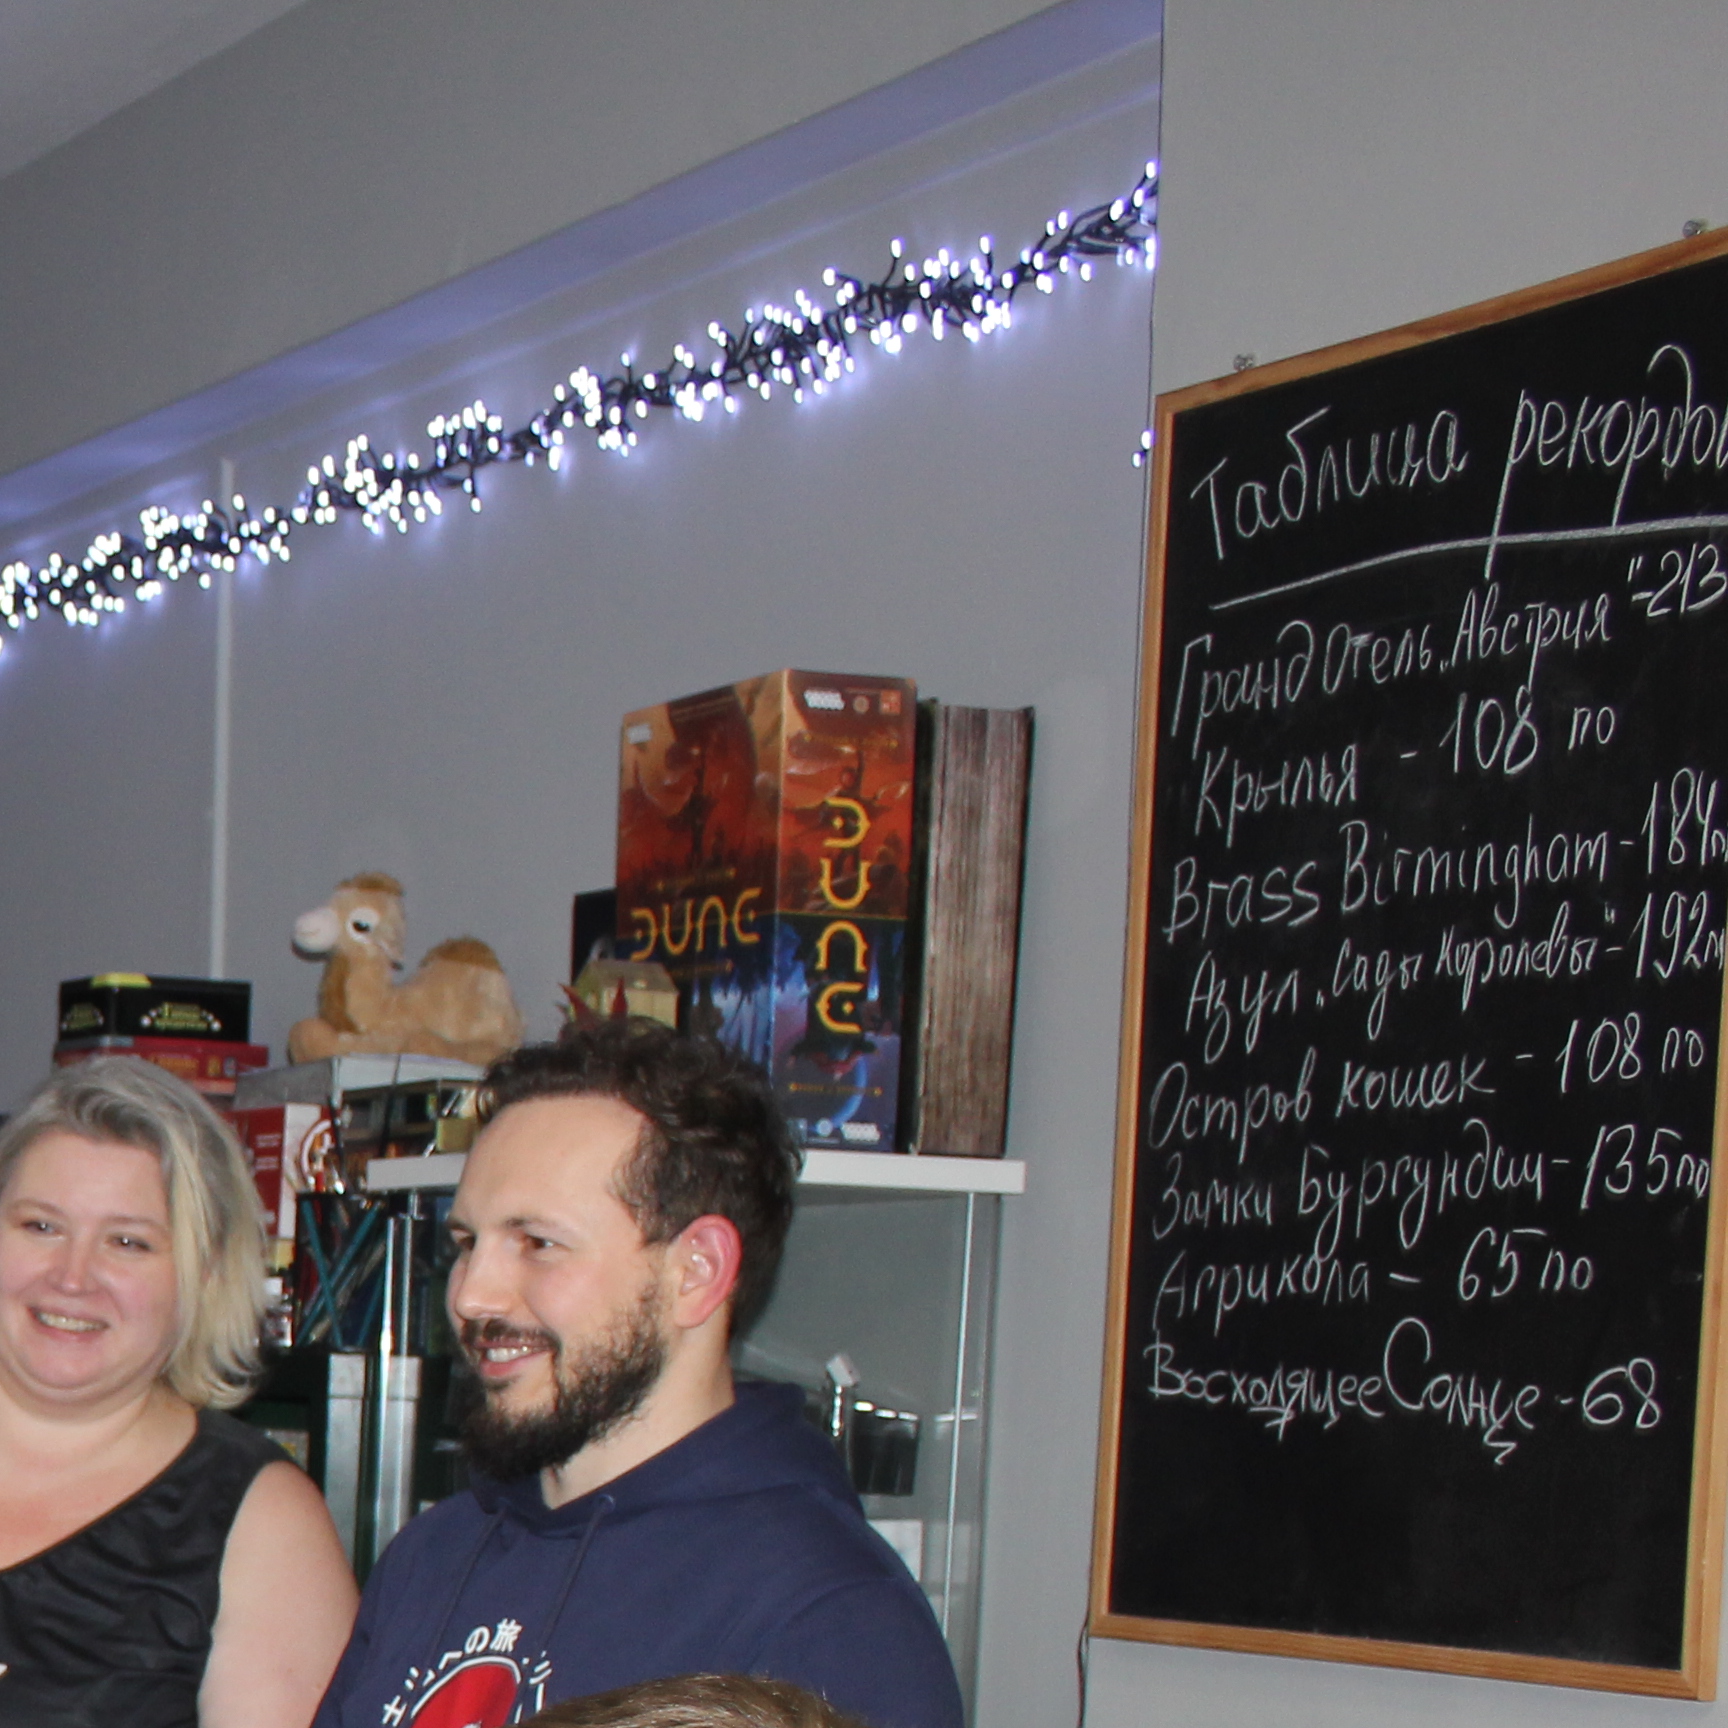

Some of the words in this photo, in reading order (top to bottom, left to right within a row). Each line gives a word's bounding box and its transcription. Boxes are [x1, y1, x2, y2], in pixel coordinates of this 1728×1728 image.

[1190, 405, 1470, 560] Таблица
[1194, 742, 1358, 849] Крылья
[1438, 685, 1540, 776] 108
[1567, 704, 1616, 752] по
[629, 886, 763, 963] DUNE
[814, 796, 872, 1034] DUNE
[1162, 856, 1321, 945] Brass
[1339, 813, 1608, 930] Birmingham
[1185, 950, 1300, 1064] Азул
[1148, 1045, 1316, 1165] Остров
[1335, 1055, 1496, 1118] кошек
[1554, 1012, 1642, 1094] 108
[1662, 1026, 1705, 1074] по
[1151, 1150, 1275, 1241] Замки
[1151, 1249, 1370, 1337] Агрикола
[1143, 1328, 1384, 1442] Восходящее
[1383, 1316, 1543, 1465] Солнце
[1580, 1356, 1663, 1429] 68
